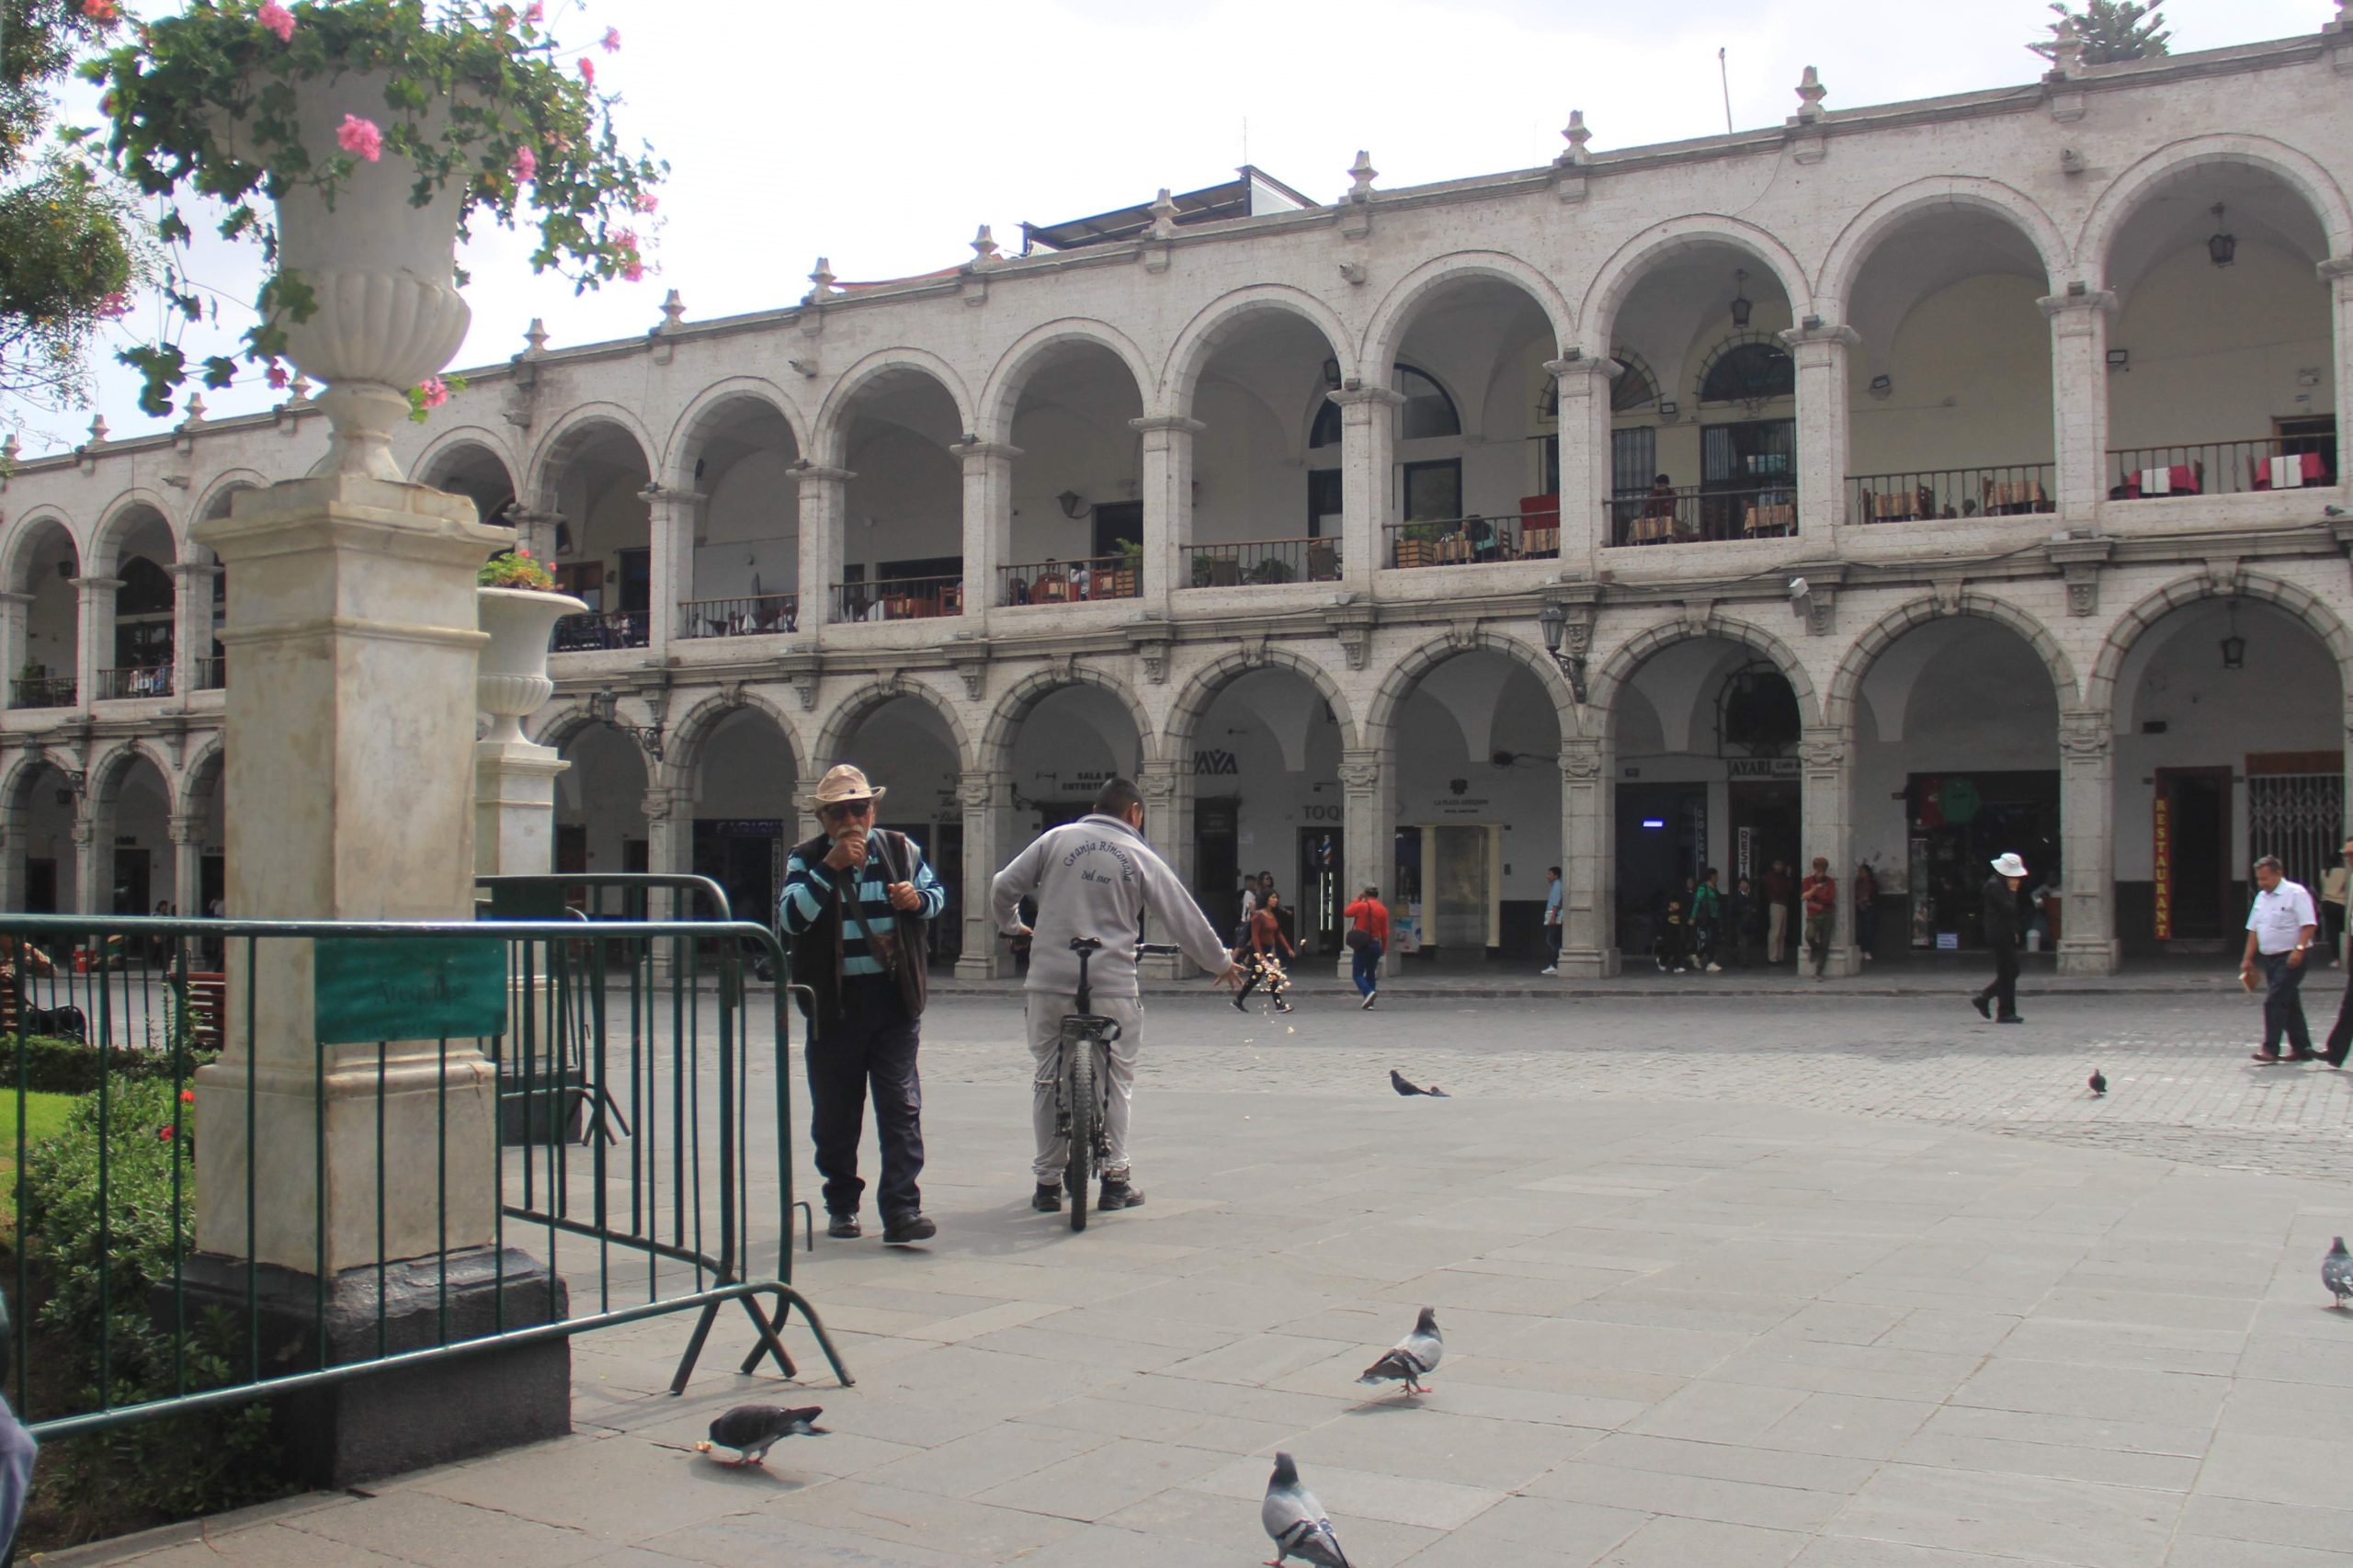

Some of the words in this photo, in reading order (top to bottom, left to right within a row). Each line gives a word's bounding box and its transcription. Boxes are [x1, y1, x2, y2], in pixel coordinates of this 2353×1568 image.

[1077, 772, 1102, 780] SALA
[1063, 840, 1096, 866] Granja
[1098, 841, 1134, 881] Rinconada
[2155, 799, 2168, 937] RESTAURANT
[1081, 869, 1096, 881] del
[1096, 875, 1111, 884] sur
